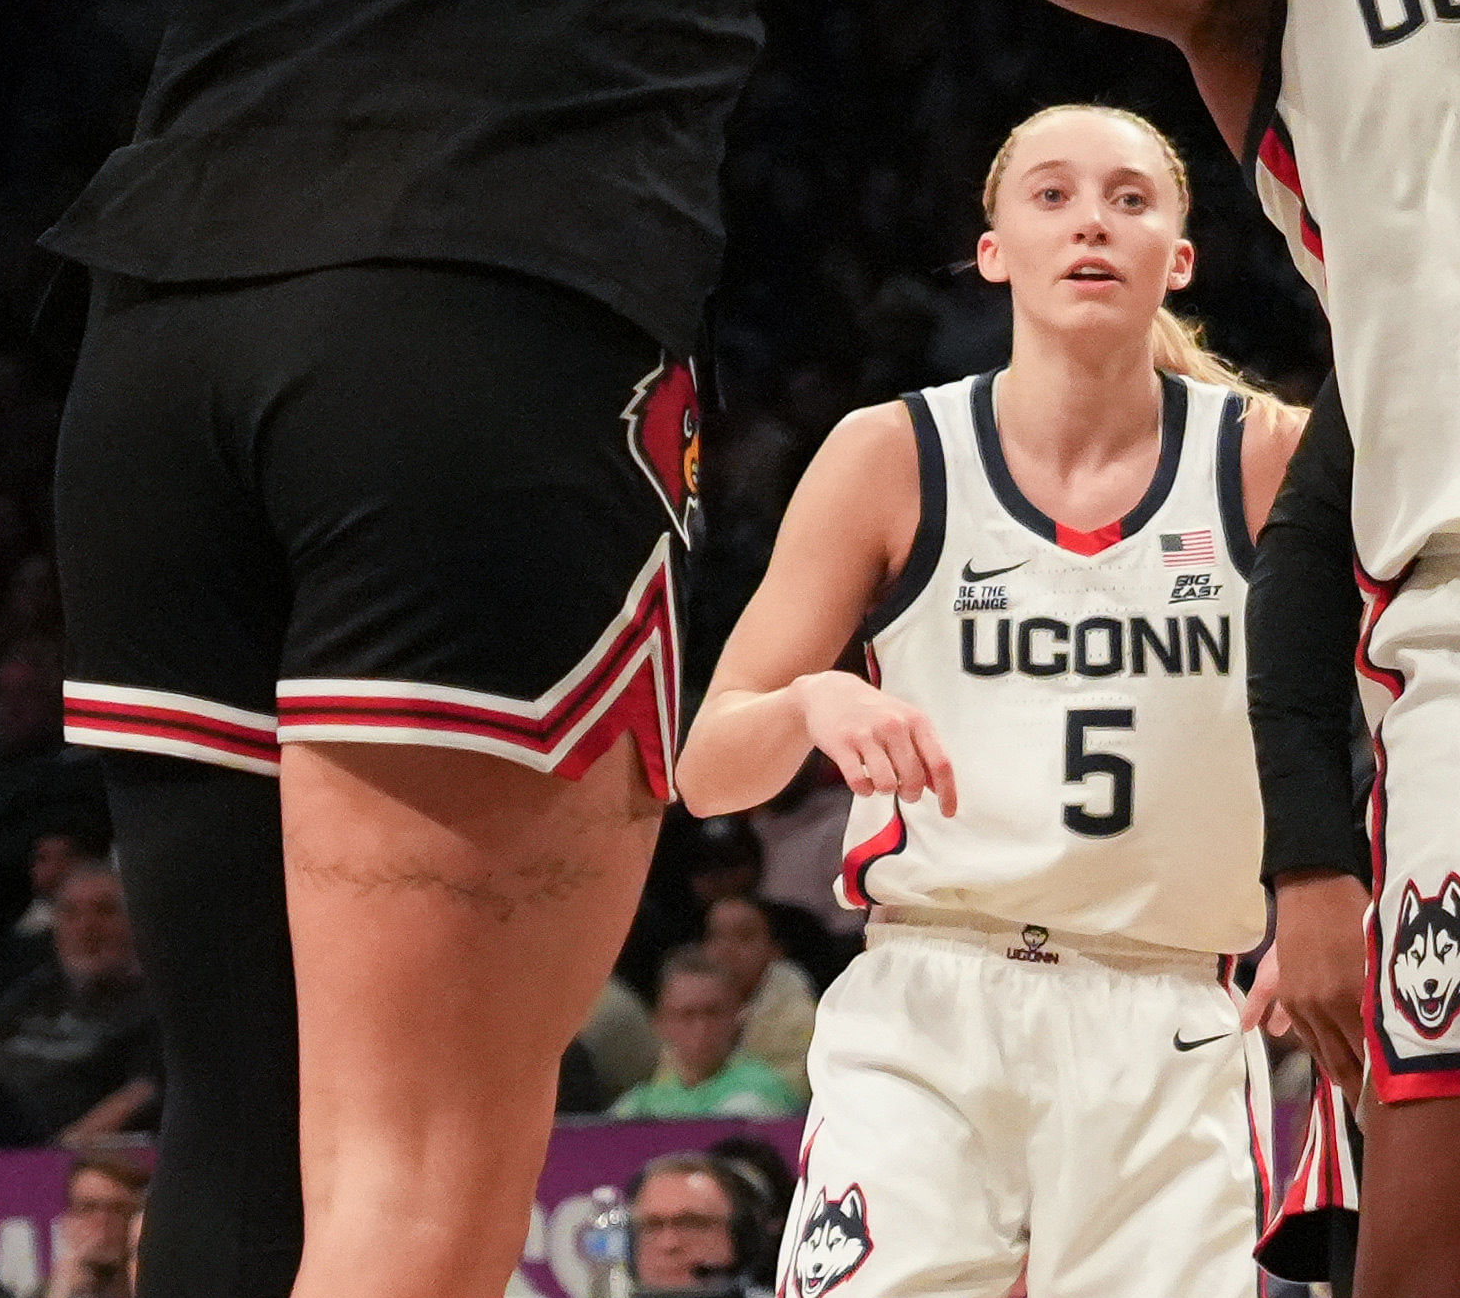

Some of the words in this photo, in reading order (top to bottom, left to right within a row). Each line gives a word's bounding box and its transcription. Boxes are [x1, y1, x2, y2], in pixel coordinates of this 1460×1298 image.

[1175, 574, 1211, 587] BIG
[958, 586, 976, 599] BE
[981, 586, 1007, 598] THE
[1170, 585, 1223, 599] EAST
[953, 598, 1008, 612] CHANGE
[959, 614, 1231, 681] UCONN
[1061, 707, 1137, 841] 5
